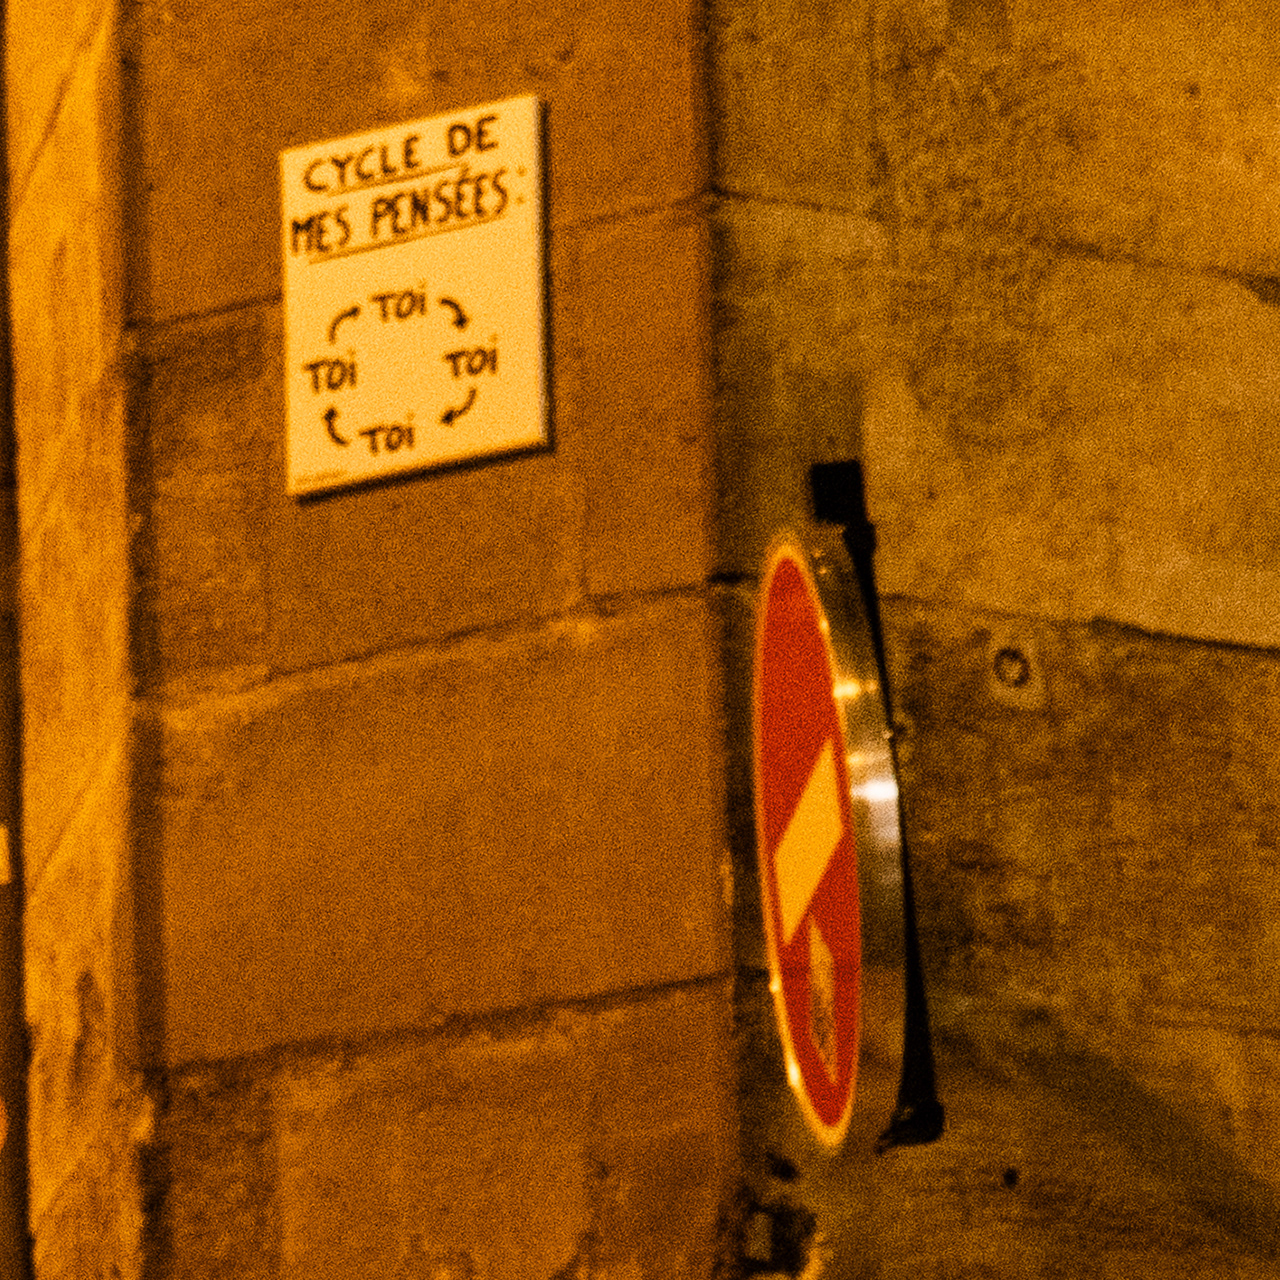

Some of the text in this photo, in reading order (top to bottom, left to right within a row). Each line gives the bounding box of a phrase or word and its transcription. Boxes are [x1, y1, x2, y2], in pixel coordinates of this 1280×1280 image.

[303, 113, 499, 193] CYCLE DE
[291, 203, 351, 257] MES
